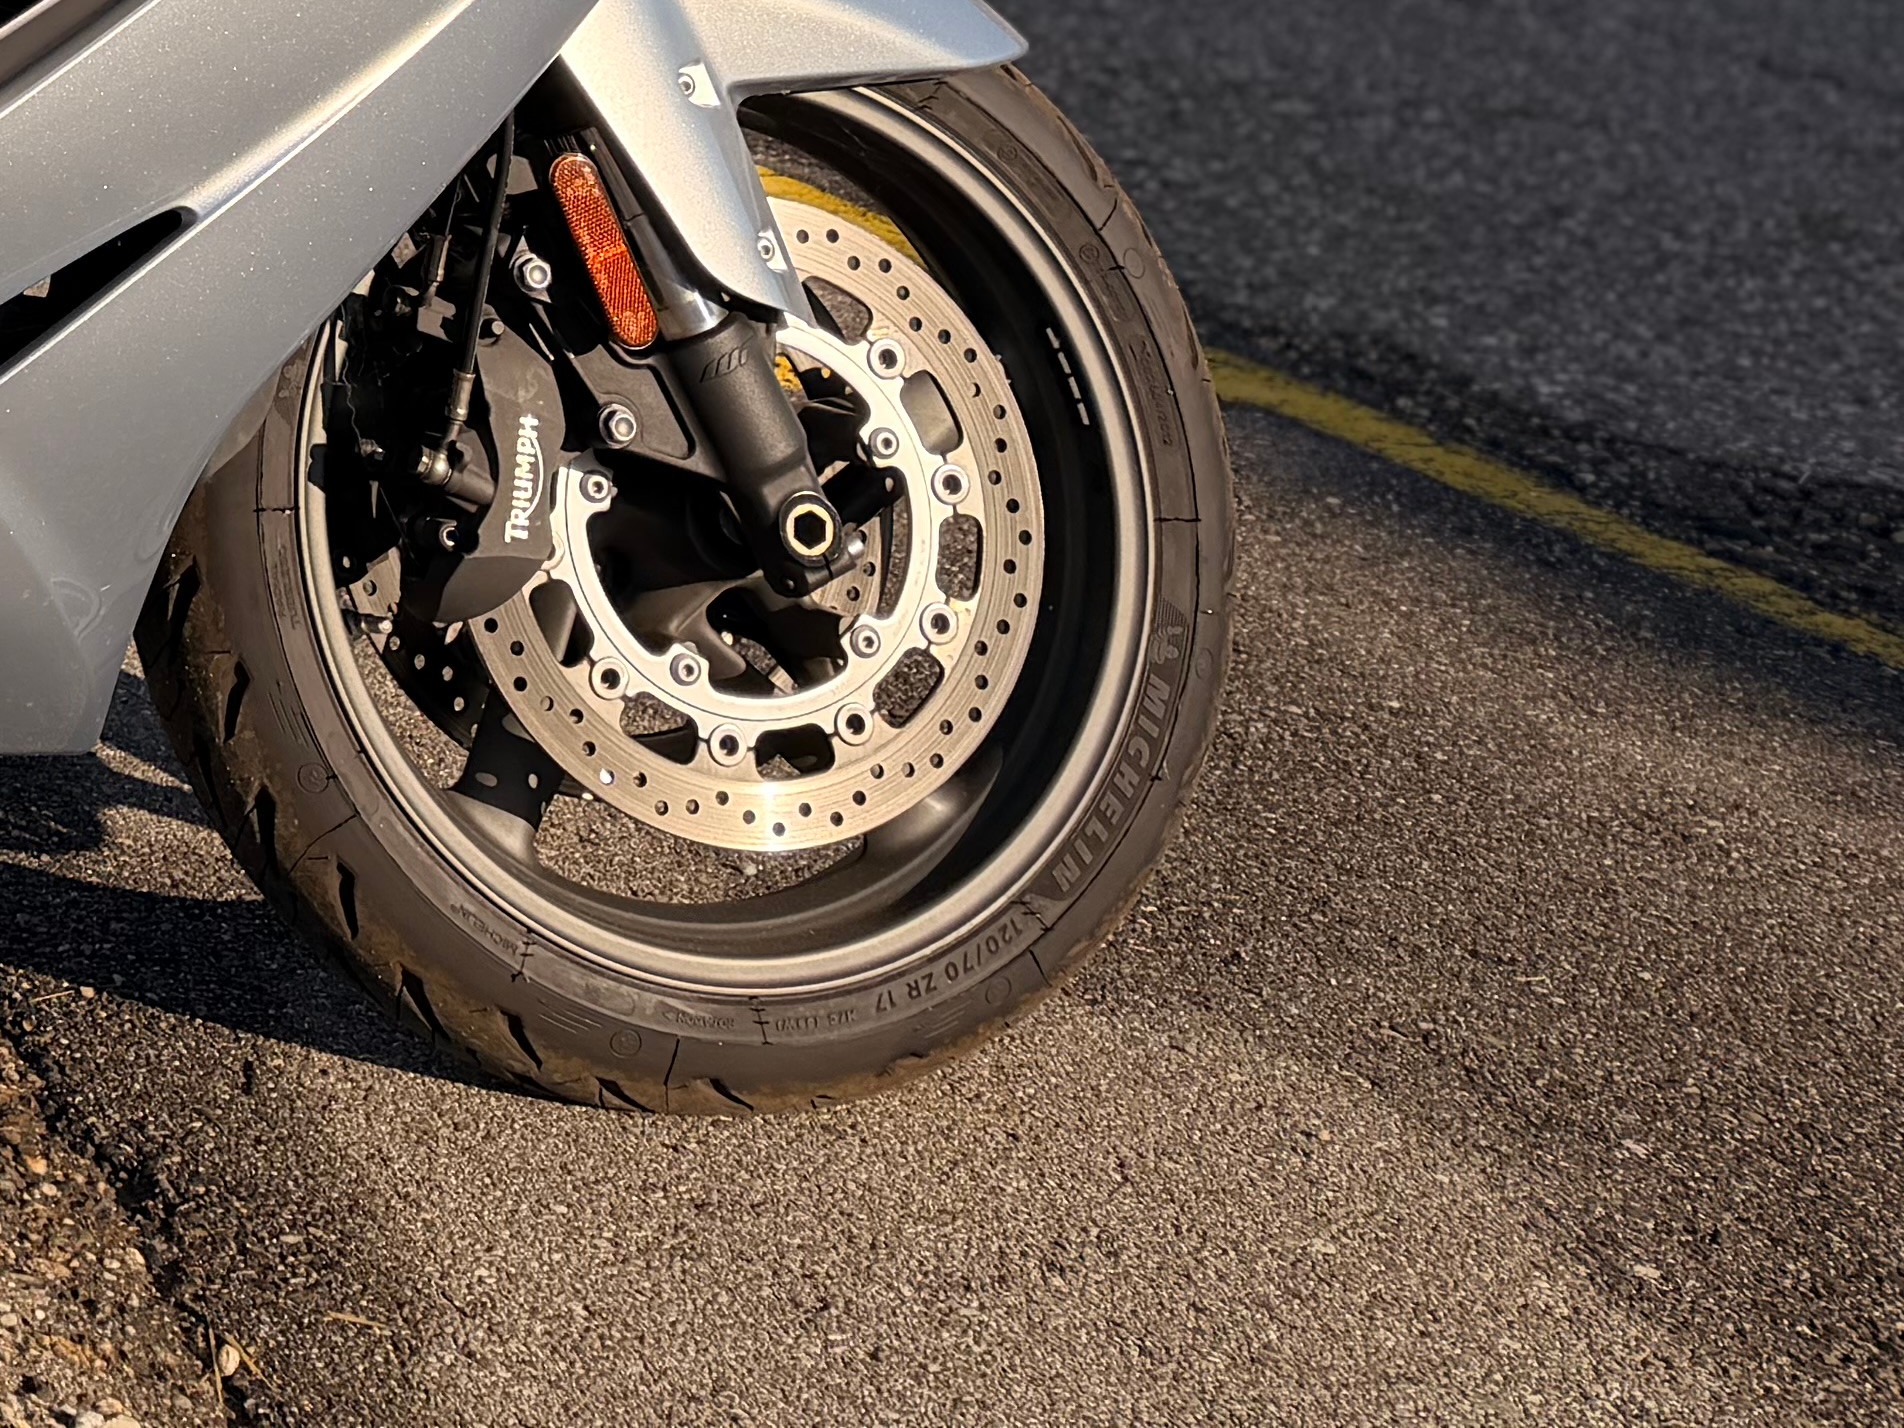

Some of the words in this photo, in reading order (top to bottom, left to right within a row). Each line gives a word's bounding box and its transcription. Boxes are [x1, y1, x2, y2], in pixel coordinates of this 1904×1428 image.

[504, 413, 544, 544] TRIUMPH
[1052, 673, 1171, 893] MICHELIN
[945, 915, 1024, 984] 120/70
[874, 990, 894, 1014] 17
[908, 974, 938, 1001] ZR
